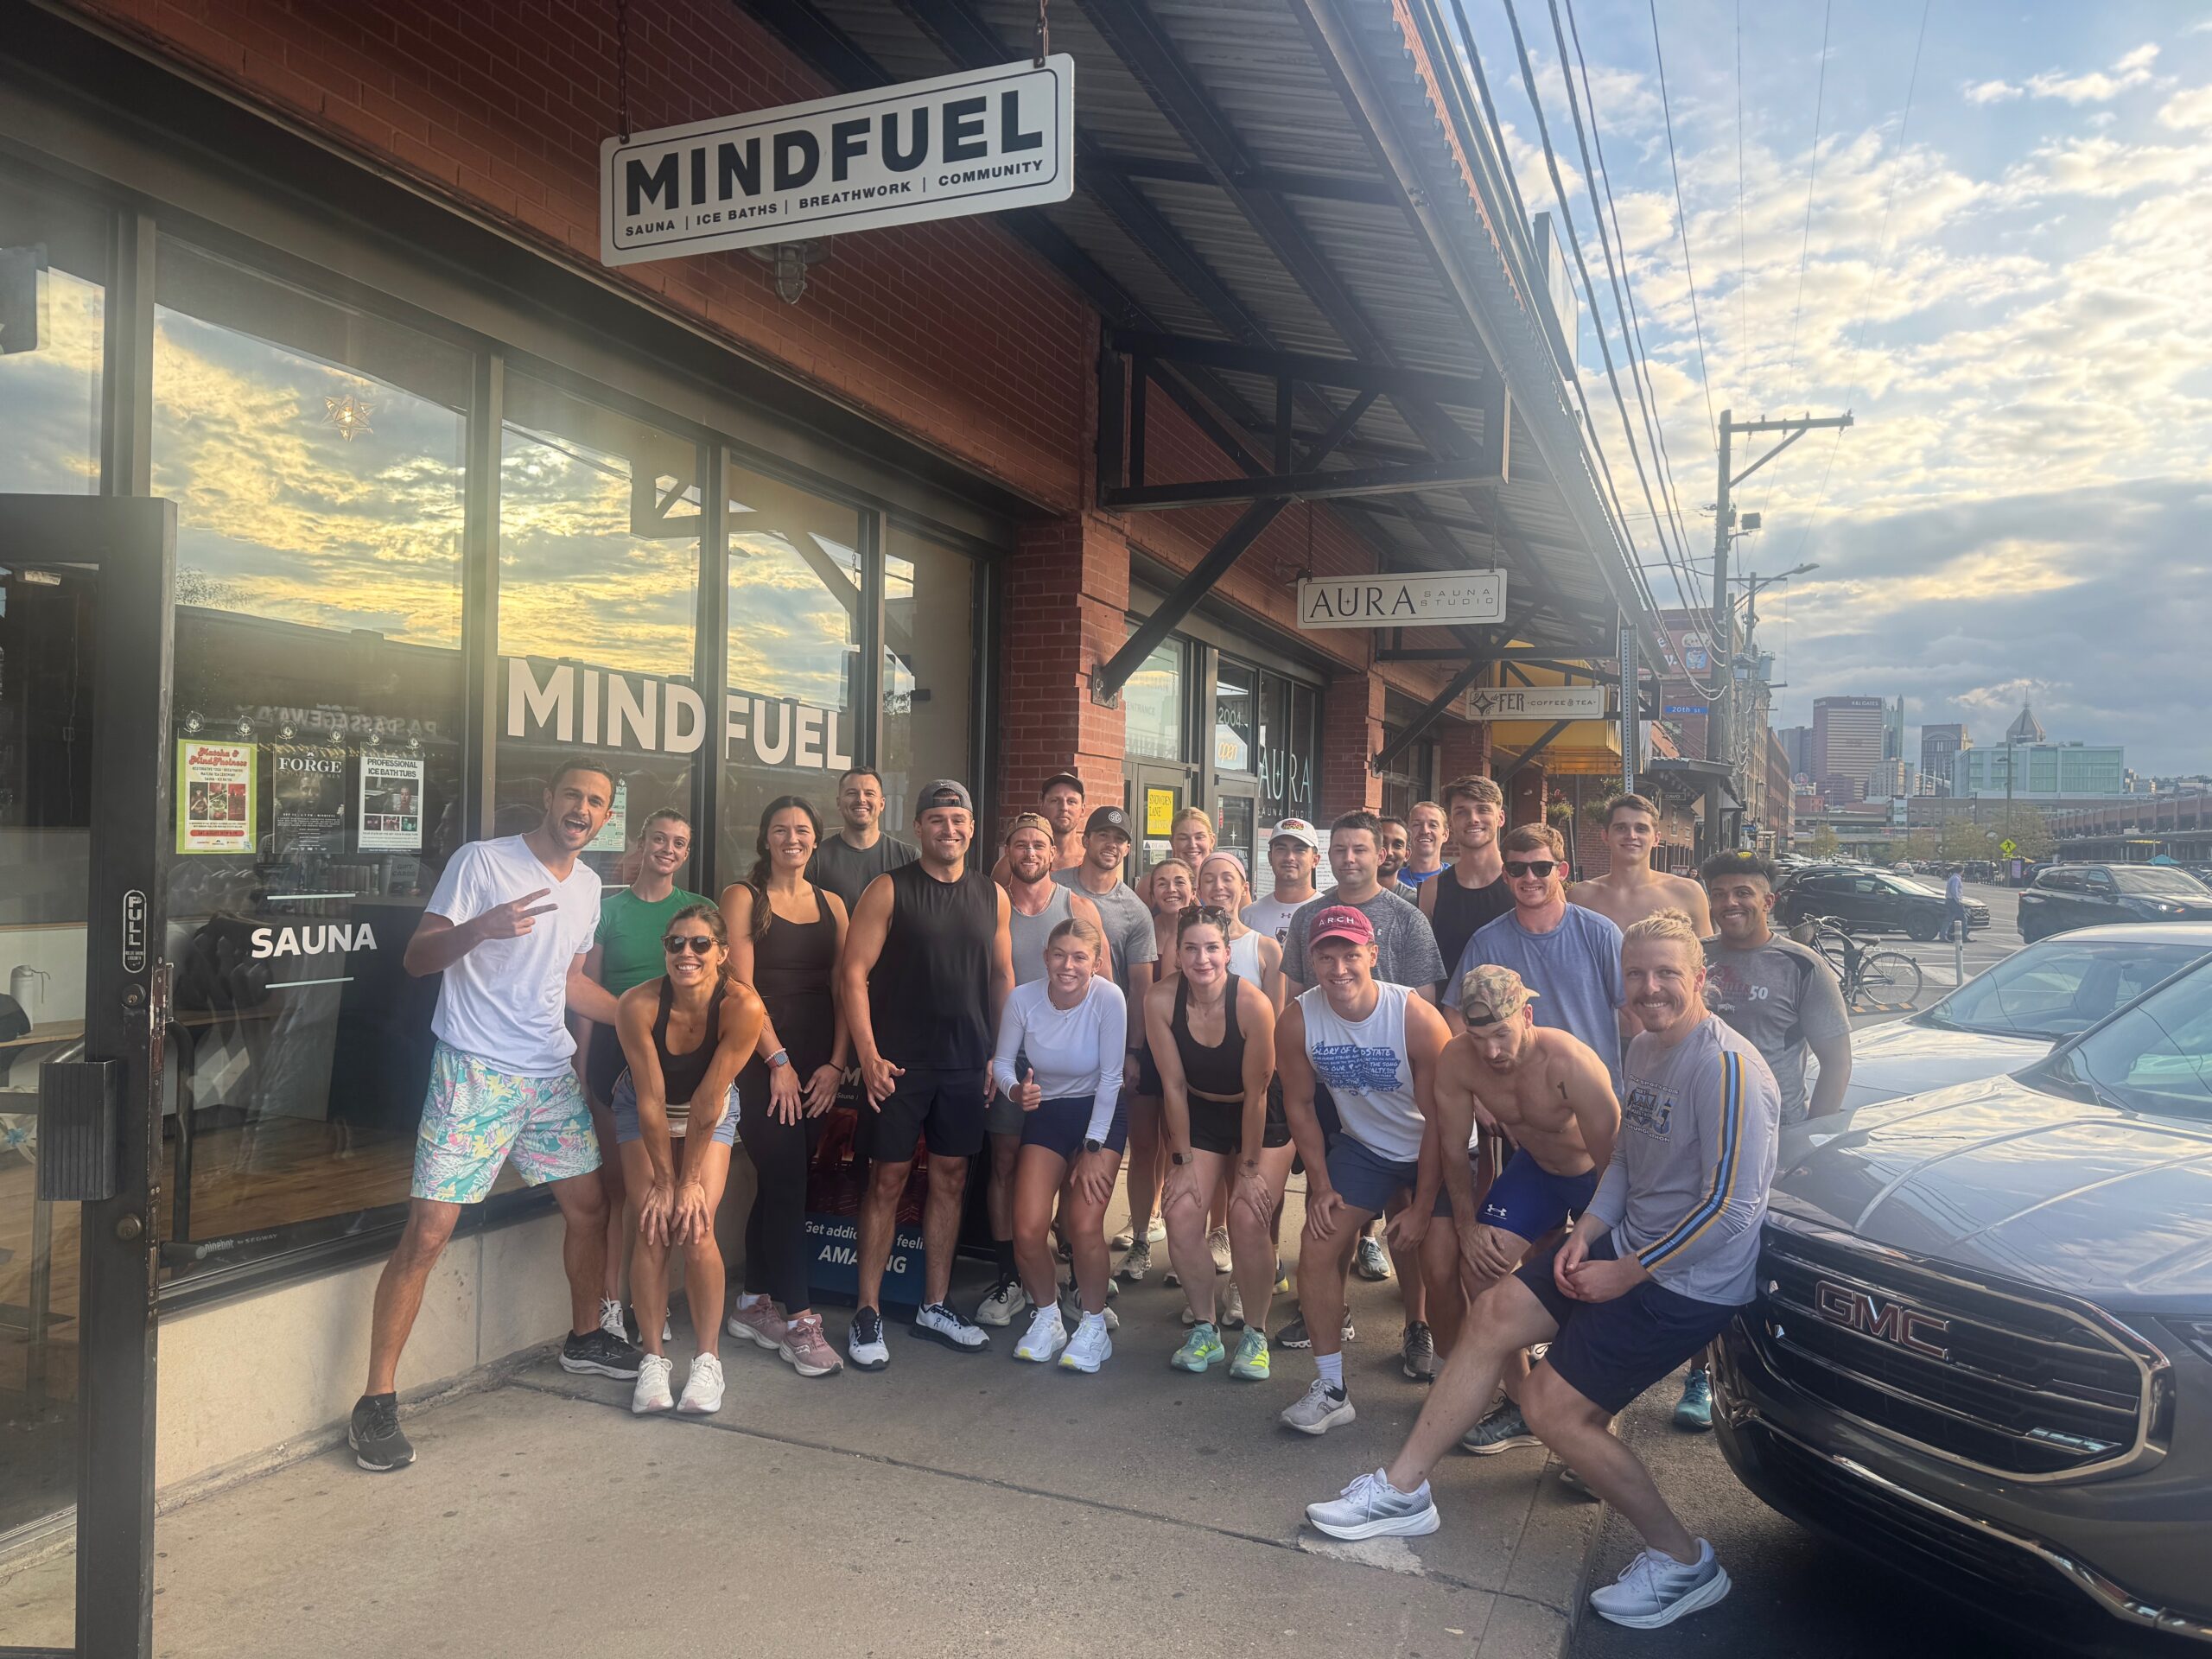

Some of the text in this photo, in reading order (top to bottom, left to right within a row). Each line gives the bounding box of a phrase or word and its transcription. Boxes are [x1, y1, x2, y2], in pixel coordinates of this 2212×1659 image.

[625, 90, 1043, 216] MINDFUEL
[626, 159, 1044, 237] SAUNA ICE BATHS BREATHWORK COMMUNITY
[1309, 585, 1417, 618] AURA
[1421, 597, 1494, 607] STUDIO
[1423, 588, 1491, 598] SAUNA
[1498, 693, 1524, 712] FER
[507, 657, 852, 770] MIND FUEL
[1217, 707, 1241, 728] 2004
[278, 757, 342, 773] FORGE
[367, 758, 418, 769] PROFESSIONAL
[380, 768, 399, 777] BATH
[398, 769, 416, 778] TUBS
[1258, 747, 1312, 804] AURA
[1148, 806, 1161, 817] LANE
[128, 896, 143, 946] PULL
[1319, 917, 1355, 927] ARCH
[251, 922, 378, 959] SAUNA
[1748, 985, 1769, 1001] 50
[204, 1238, 234, 1253] ninebot
[1815, 1279, 1951, 1363] GMC
